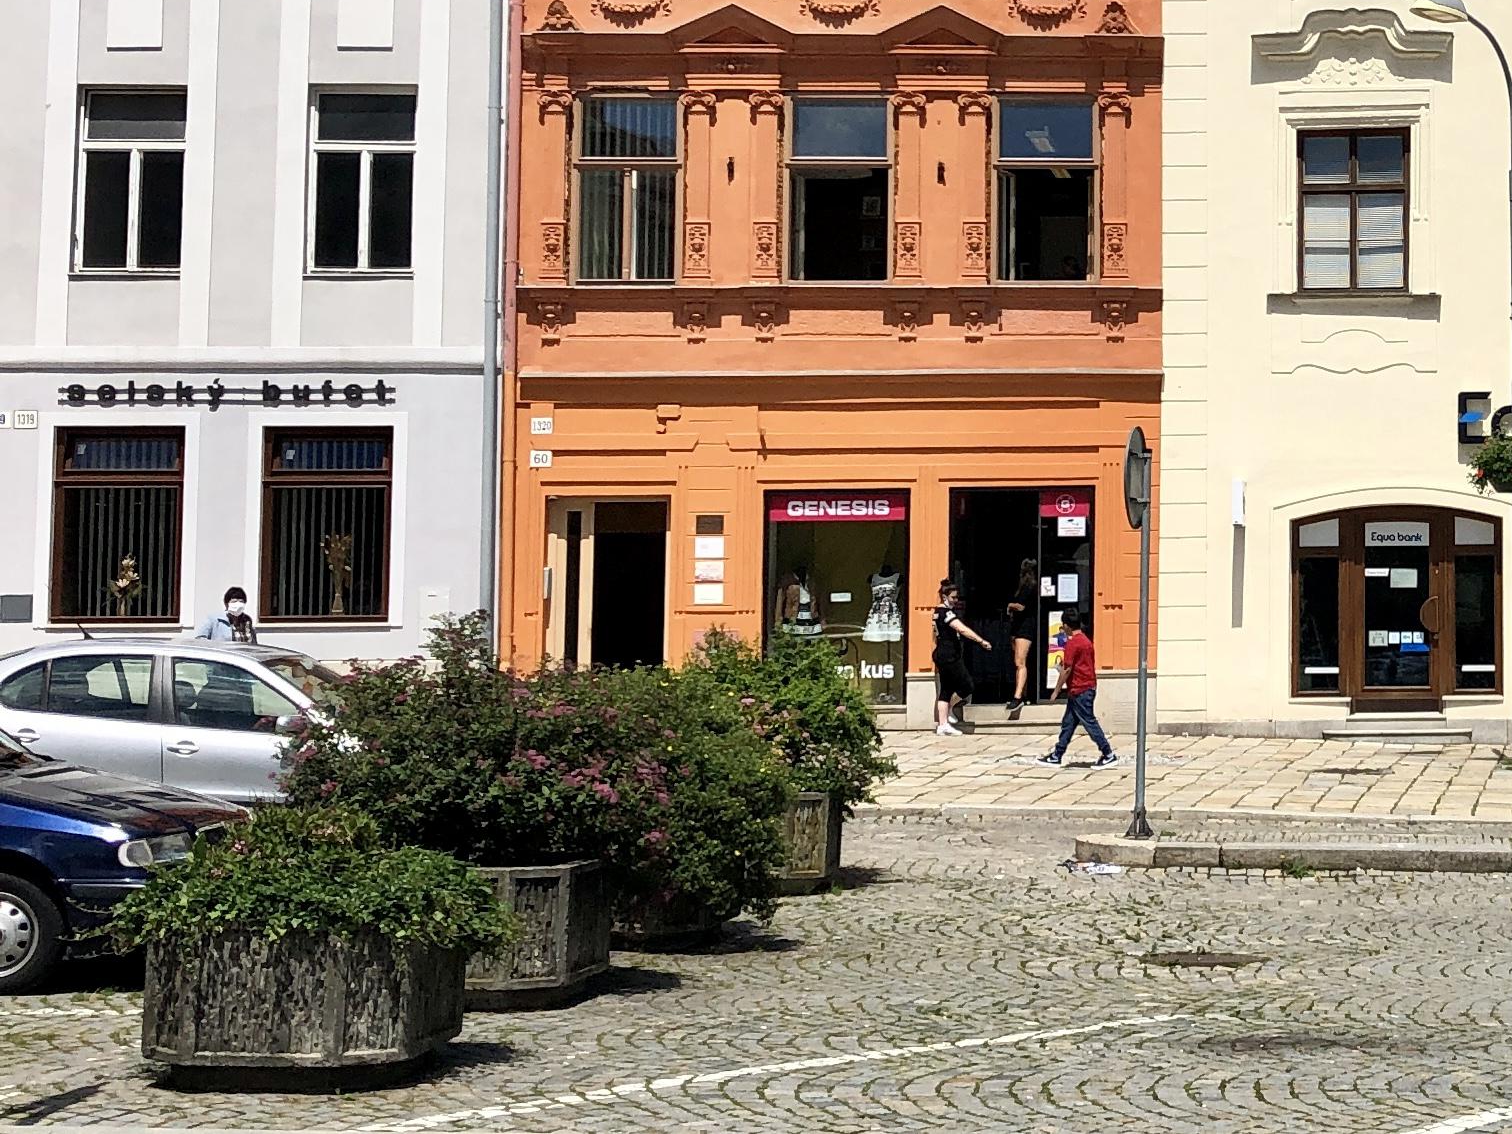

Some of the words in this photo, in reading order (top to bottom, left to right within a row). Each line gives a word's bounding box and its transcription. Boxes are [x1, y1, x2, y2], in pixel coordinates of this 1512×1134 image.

[67, 378, 224, 412] selský
[262, 380, 386, 402] bufet
[17, 413, 35, 425] 1319
[533, 453, 548, 464] 60
[786, 500, 890, 516] GENESIS
[1370, 531, 1396, 543] Equa
[1397, 532, 1423, 542] bank
[860, 659, 895, 679] kus
